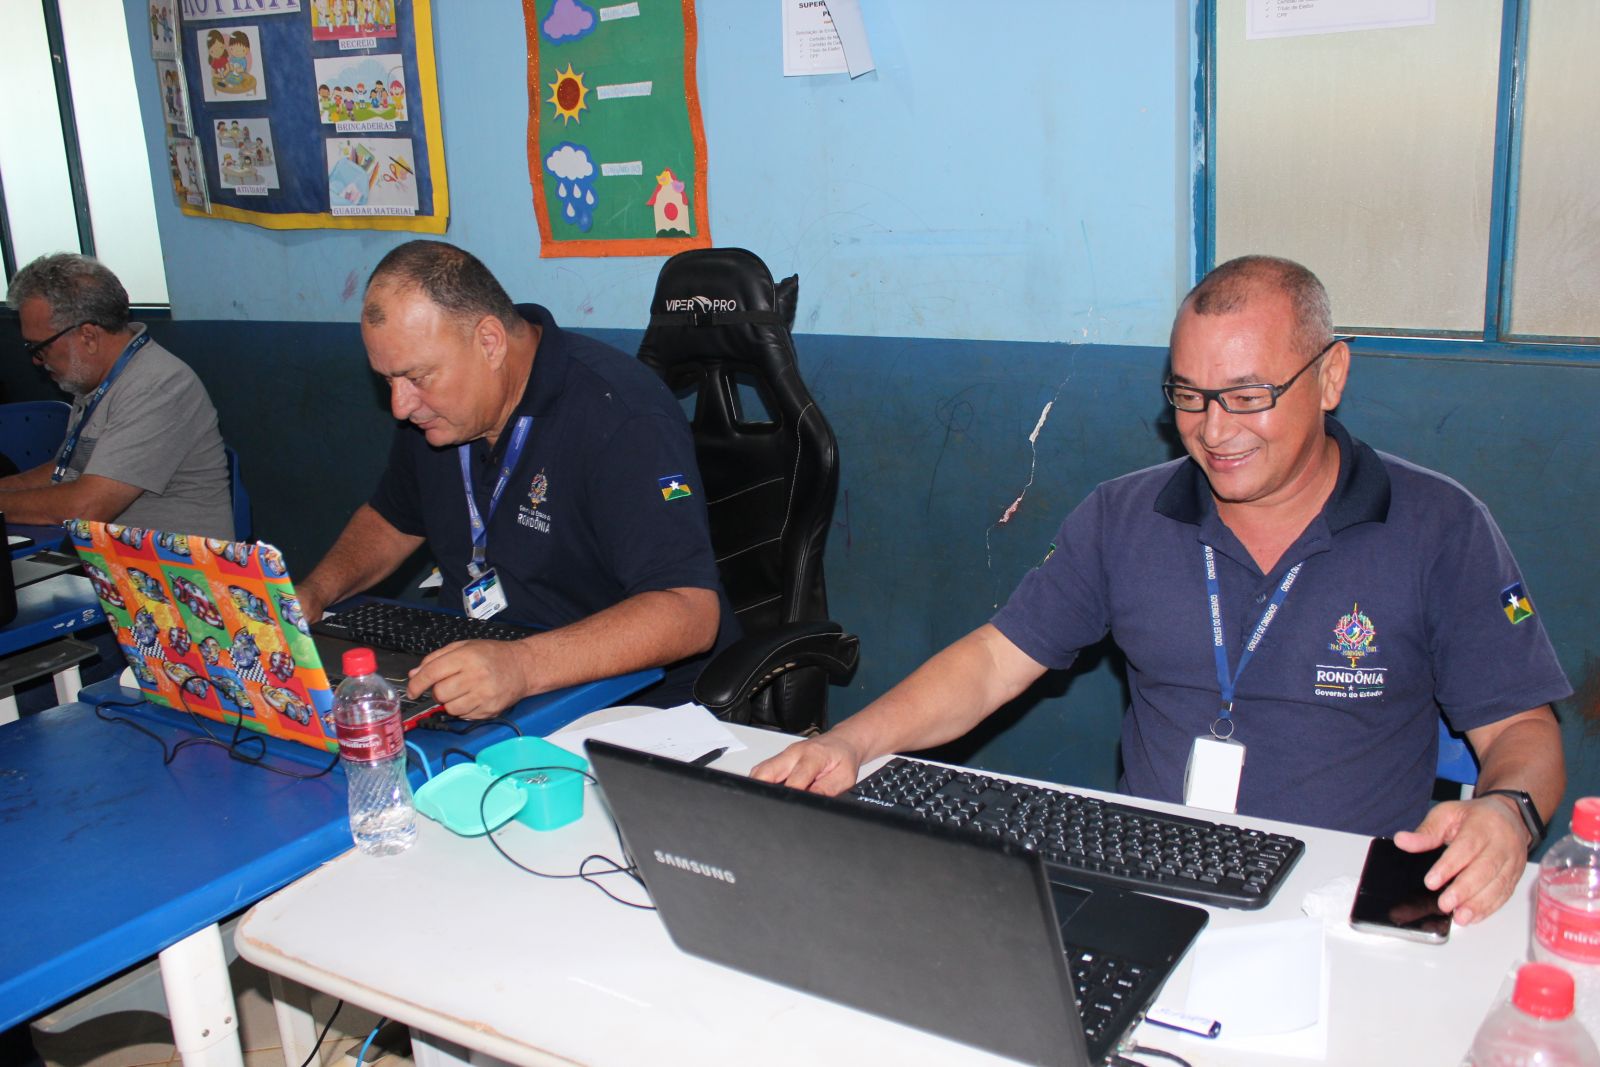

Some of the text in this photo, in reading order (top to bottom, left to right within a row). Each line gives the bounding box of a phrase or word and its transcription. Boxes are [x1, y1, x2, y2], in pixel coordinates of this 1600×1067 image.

[340, 38, 375, 48] RECREIO
[337, 121, 395, 131] BRINCADEIRAS
[333, 206, 414, 215] GUARDAR MATERIAL
[665, 299, 737, 311] VIPER PRO
[1206, 560, 1216, 580] ESTADO
[1280, 572, 1296, 592] ESTADO
[1210, 594, 1223, 646] GOVERNO DO ESTADO
[1247, 603, 1278, 652] GOVERNO DO ESTADO
[1316, 670, 1384, 685] RONDÔNIA
[1314, 688, 1347, 698] Governo
[1359, 690, 1383, 698] Estado
[653, 849, 736, 884] SAMSUNG
